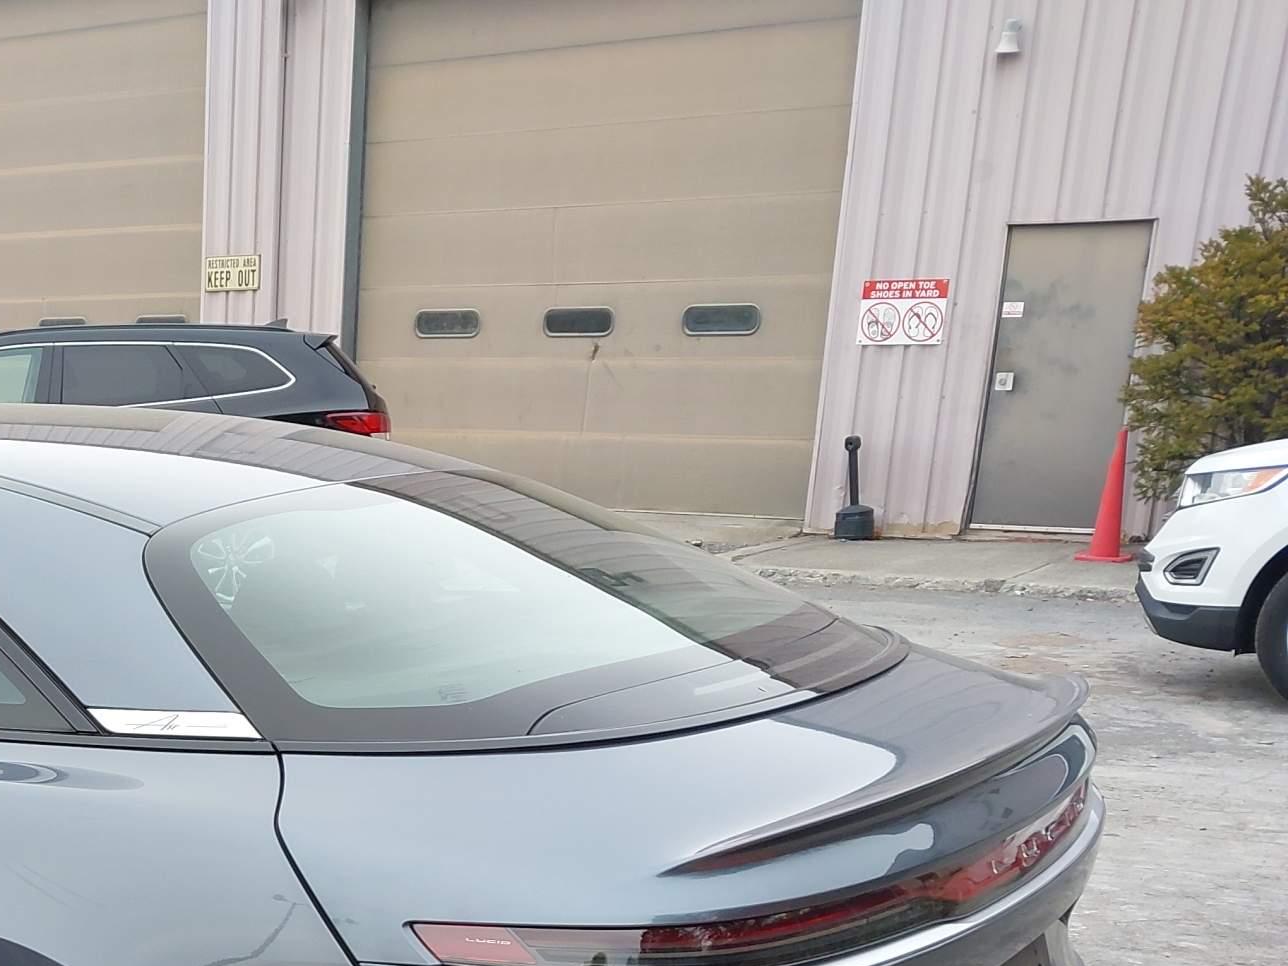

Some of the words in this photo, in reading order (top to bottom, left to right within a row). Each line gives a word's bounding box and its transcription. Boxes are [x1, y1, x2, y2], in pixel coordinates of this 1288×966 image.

[208, 258, 239, 269] RESTRICTED
[243, 257, 257, 267] AREA
[207, 270, 231, 288] KEEP
[238, 269, 256, 287] OUT
[875, 282, 889, 290] NO
[891, 281, 915, 290] OPEN
[918, 281, 936, 289] TOE
[870, 290, 900, 298] SHOES
[902, 290, 913, 298] IN
[914, 289, 940, 297] YARD
[465, 937, 512, 945] LUCID
